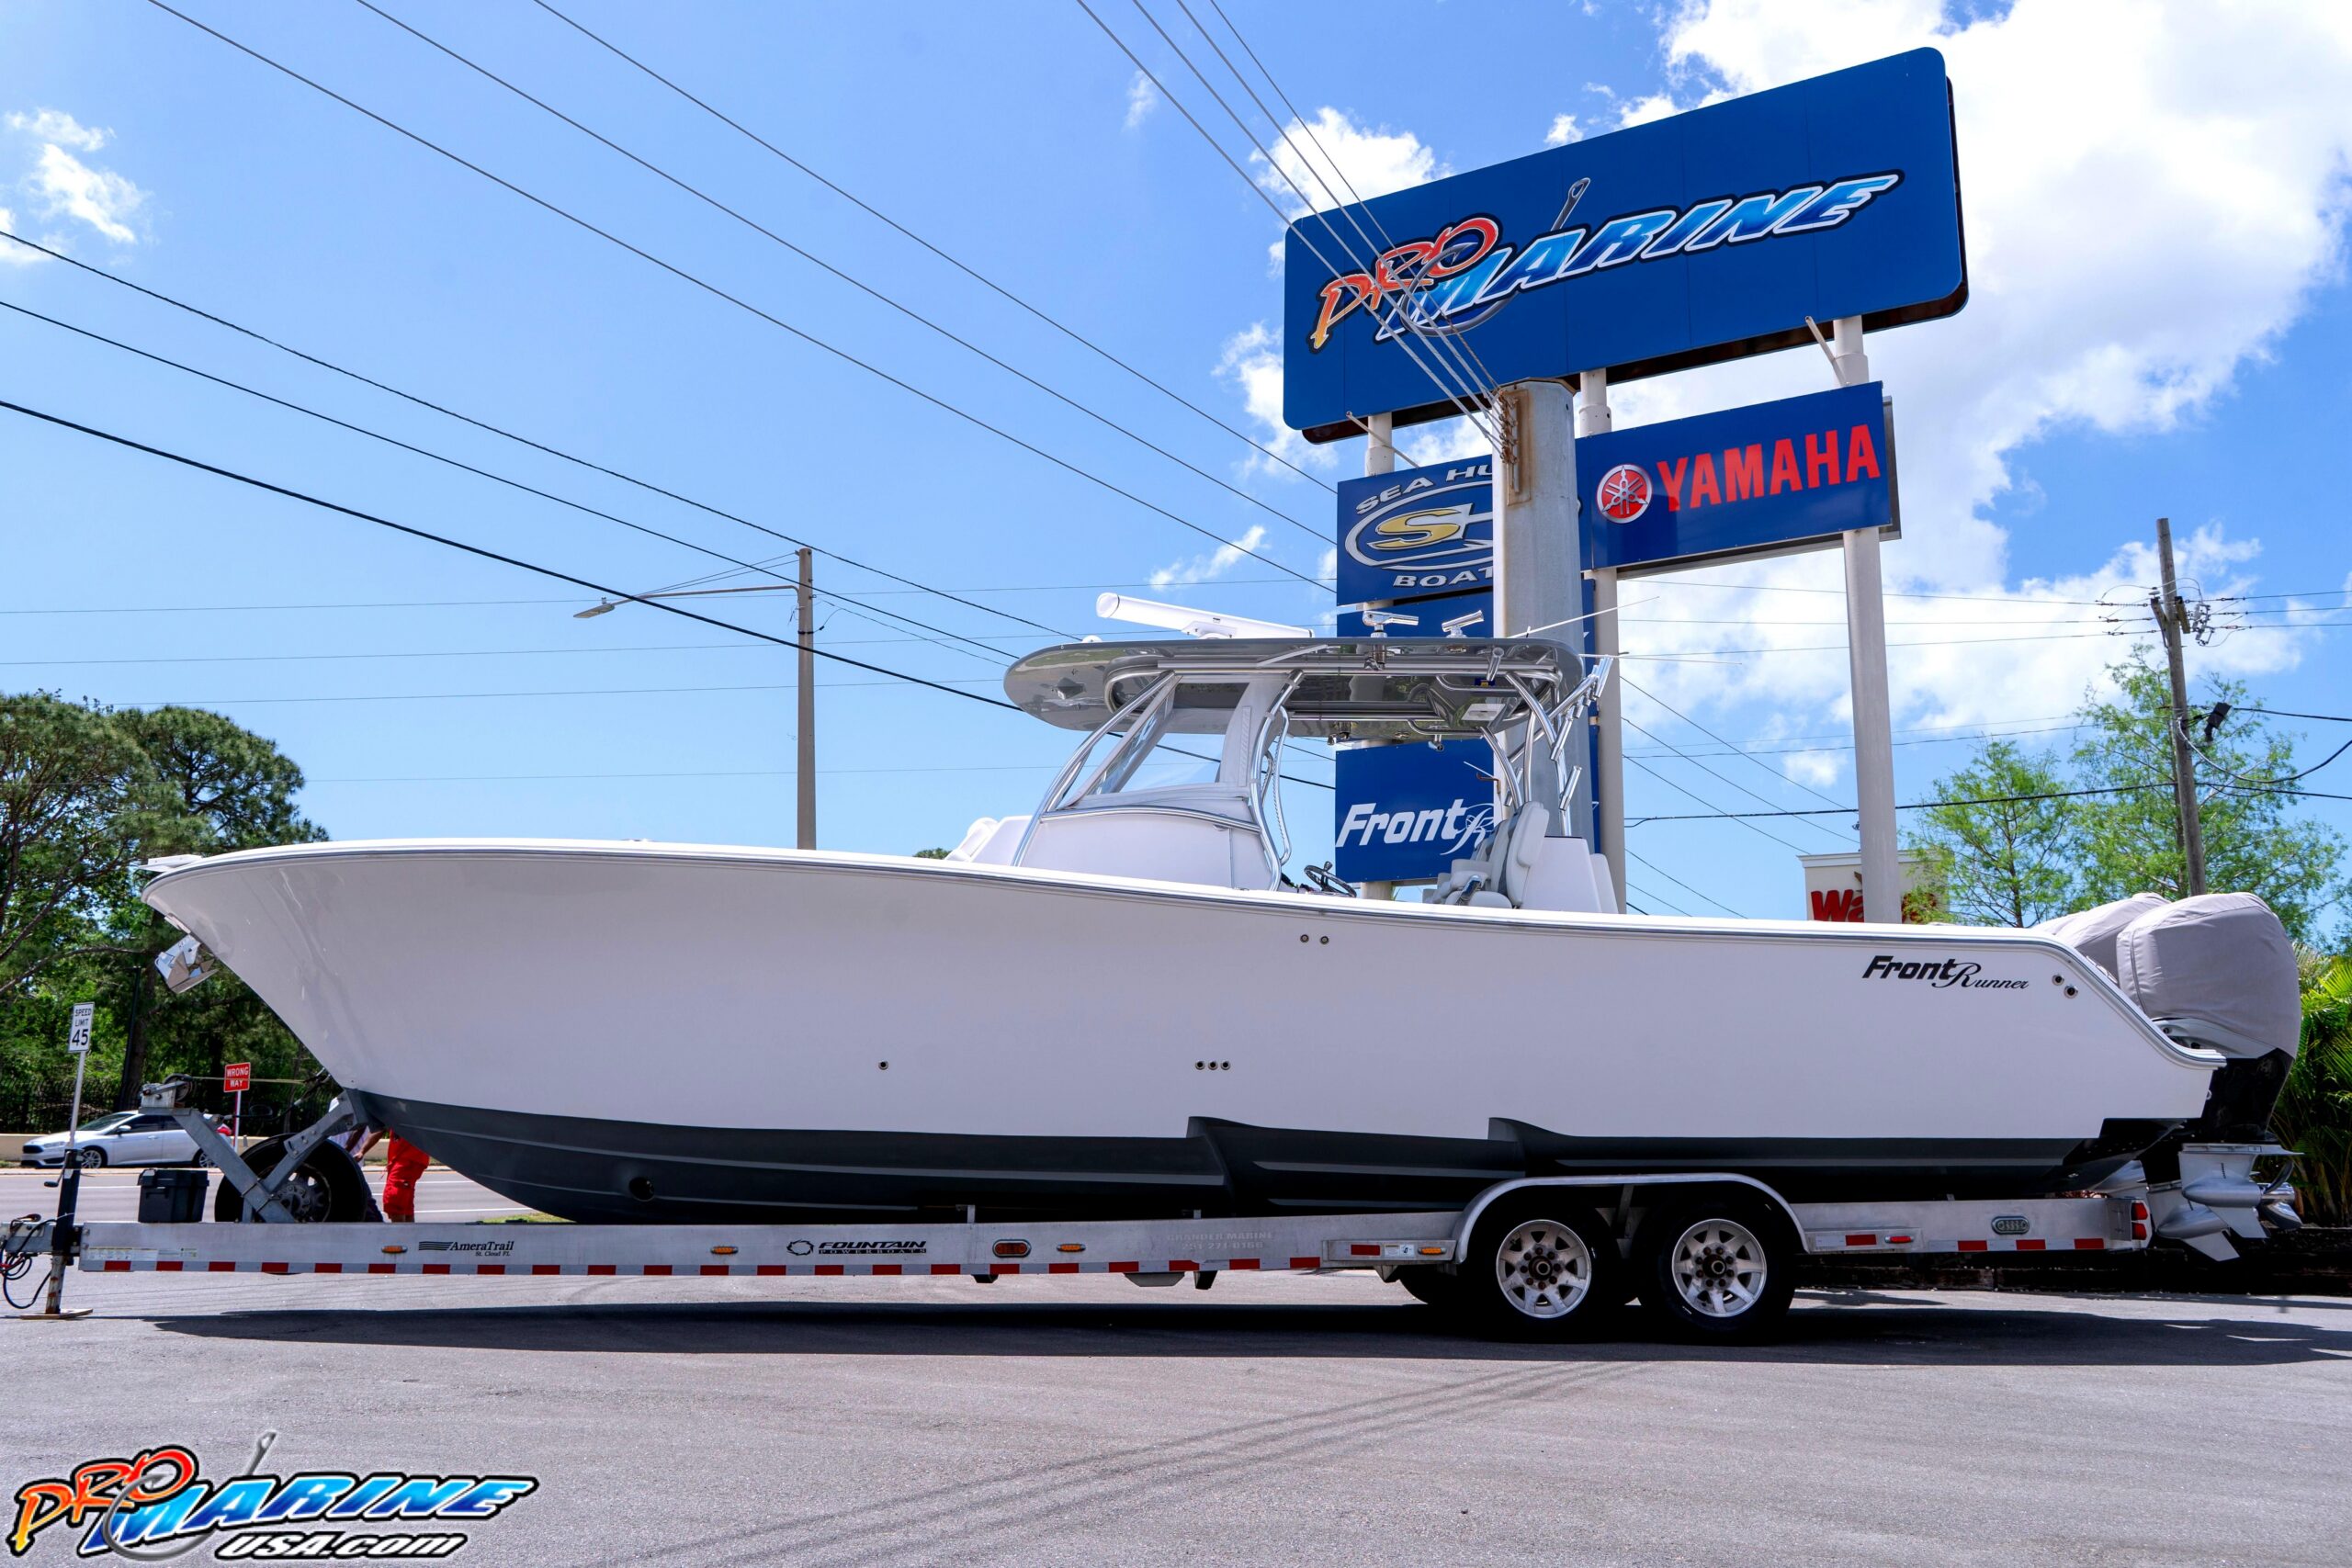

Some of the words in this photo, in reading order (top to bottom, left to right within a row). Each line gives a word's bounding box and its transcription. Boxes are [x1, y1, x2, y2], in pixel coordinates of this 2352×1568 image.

[1375, 173, 1902, 342] MARINE
[1309, 217, 1499, 349] PRO
[1657, 424, 1881, 512] YAMAHA
[1355, 477, 1434, 514] SEA
[1393, 566, 1493, 587] BOAT
[74, 1008, 92, 1017] SPEED
[74, 1018, 89, 1027] LIMIT
[72, 1029, 89, 1046] 45
[226, 1066, 249, 1077] WRONG
[230, 1079, 243, 1088] WAY
[1227, 1231, 1273, 1240] MARINE
[449, 1241, 514, 1251] AmeraTrail
[819, 1241, 927, 1249] FOUNTAIN
